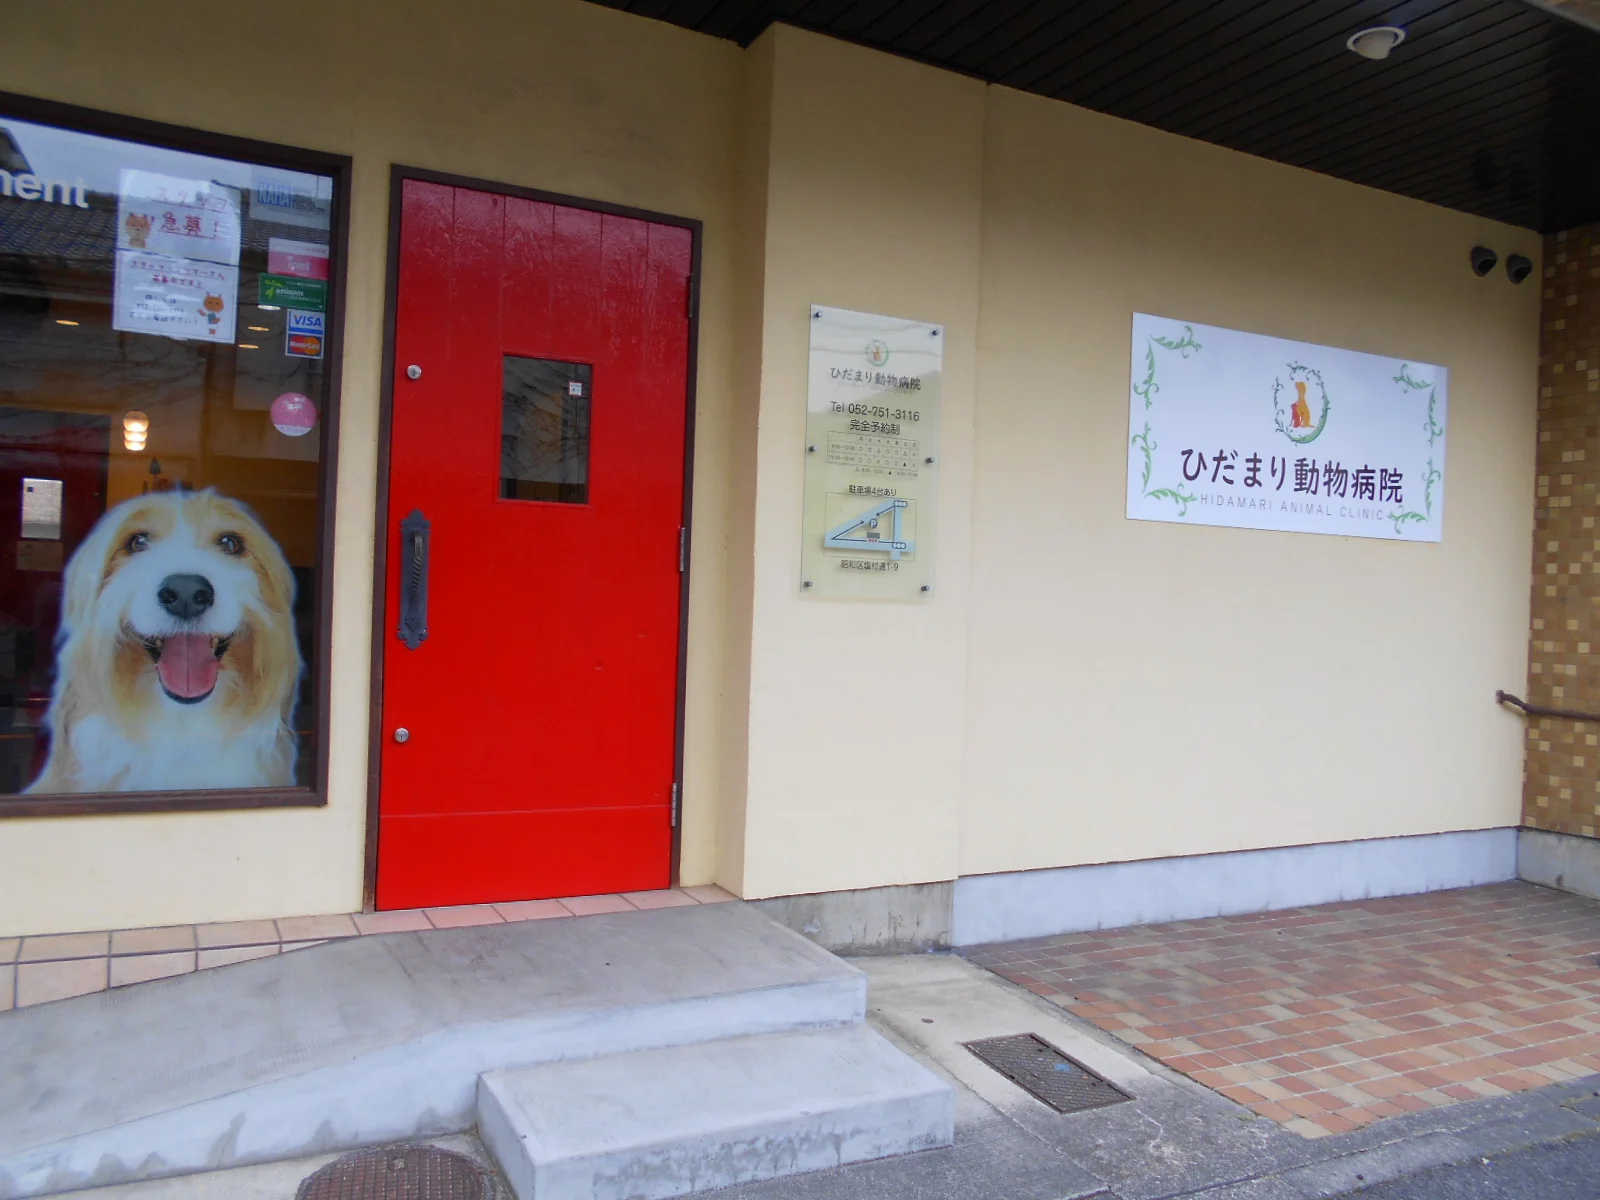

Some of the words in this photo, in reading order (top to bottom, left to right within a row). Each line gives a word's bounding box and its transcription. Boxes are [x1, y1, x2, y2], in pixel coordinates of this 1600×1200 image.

[294, 314, 322, 328] VISA
[830, 367, 922, 391] ひだまり動物病院
[830, 401, 845, 413] Tel
[848, 403, 920, 422] 052-751-3116
[849, 419, 901, 436] 完全予約制
[1180, 448, 1404, 504] ひだまり動物病院
[1200, 493, 1273, 511] HIDAMARI
[1280, 501, 1332, 516] ANIMAL
[1339, 506, 1384, 521] CLINIC
